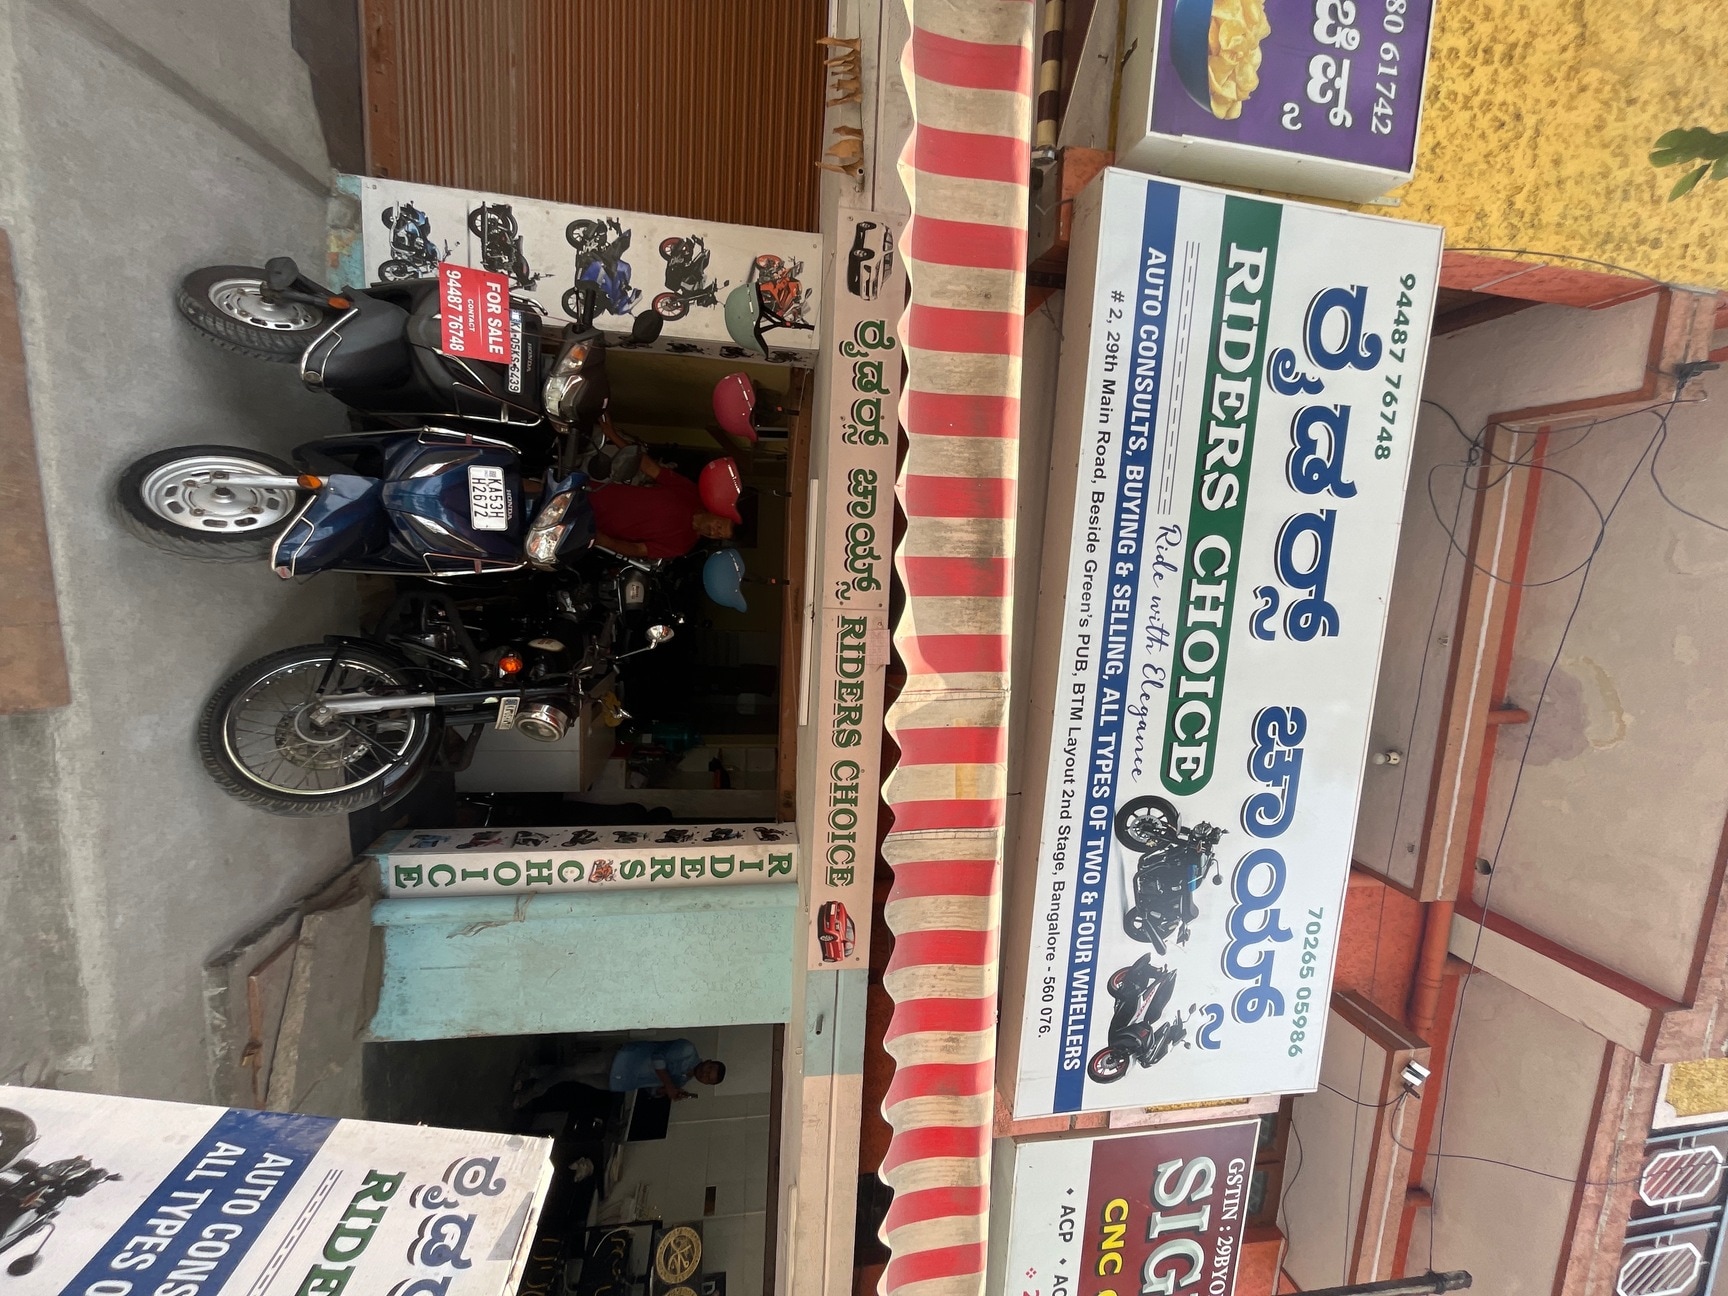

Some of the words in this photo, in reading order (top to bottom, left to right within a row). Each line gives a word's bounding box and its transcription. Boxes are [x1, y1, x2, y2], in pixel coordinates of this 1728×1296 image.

[1371, 42, 1400, 135] 61742
[446, 269, 463, 312] 94487
[486, 281, 502, 314] FOR
[1110, 290, 1125, 303] #
[1141, 246, 1167, 316] AUTO
[447, 314, 465, 352] 76748
[467, 298, 476, 332] CONTACT
[487, 317, 504, 355] SALE
[1105, 307, 1123, 324] 2,
[1388, 274, 1416, 361] 94487
[1102, 331, 1121, 373] 29th
[1200, 242, 1269, 511] RIDERS
[1098, 379, 1116, 424] Main
[1124, 324, 1159, 457] CONSULTS,
[1374, 375, 1402, 460] 76748
[1090, 431, 1111, 485] Road,
[471, 477, 488, 518] H2672
[487, 478, 504, 519] KA53H
[1085, 491, 1105, 554] Beside
[1116, 465, 1144, 556] BUYING
[1115, 561, 1132, 577] &
[1151, 524, 1183, 588] Ride
[1101, 584, 1131, 681] SELLING,
[1145, 595, 1171, 656] with
[1070, 633, 1090, 677] PUB,
[1166, 534, 1231, 783] CHOICE
[831, 615, 869, 750] RIDERS
[1068, 683, 1086, 721] BTM
[1099, 687, 1122, 727] ALL
[1128, 663, 1167, 783] Elegance
[1060, 726, 1082, 785] Layout
[1091, 732, 1116, 798] TYPES
[825, 759, 861, 889] CHOICE
[1059, 789, 1076, 820] 2nd
[1088, 805, 1108, 831] OF
[394, 859, 585, 889] CHOICE
[619, 852, 794, 882] RIDERS
[1050, 824, 1072, 876] Stage,
[1081, 837, 1106, 885] TWO
[1042, 880, 1066, 962] Bangalore
[1081, 891, 1098, 905] &
[1073, 910, 1097, 964] FOUR
[1298, 906, 1324, 980] 70265
[1040, 976, 1057, 1003] 560
[1037, 1007, 1053, 1039] 076.
[1062, 968, 1092, 1071] WHELLERS
[1287, 986, 1314, 1058] 05986
[185, 1141, 247, 1182] ALL
[232, 1152, 294, 1215] AUTO
[1220, 1158, 1246, 1220] GSTIN
[104, 1188, 209, 1271] TYPES
[1058, 1205, 1076, 1243] ACP
[1098, 1198, 1129, 1277] CNC
[1141, 1156, 1217, 1296] SIG
[1209, 1236, 1233, 1296] 29BYO
